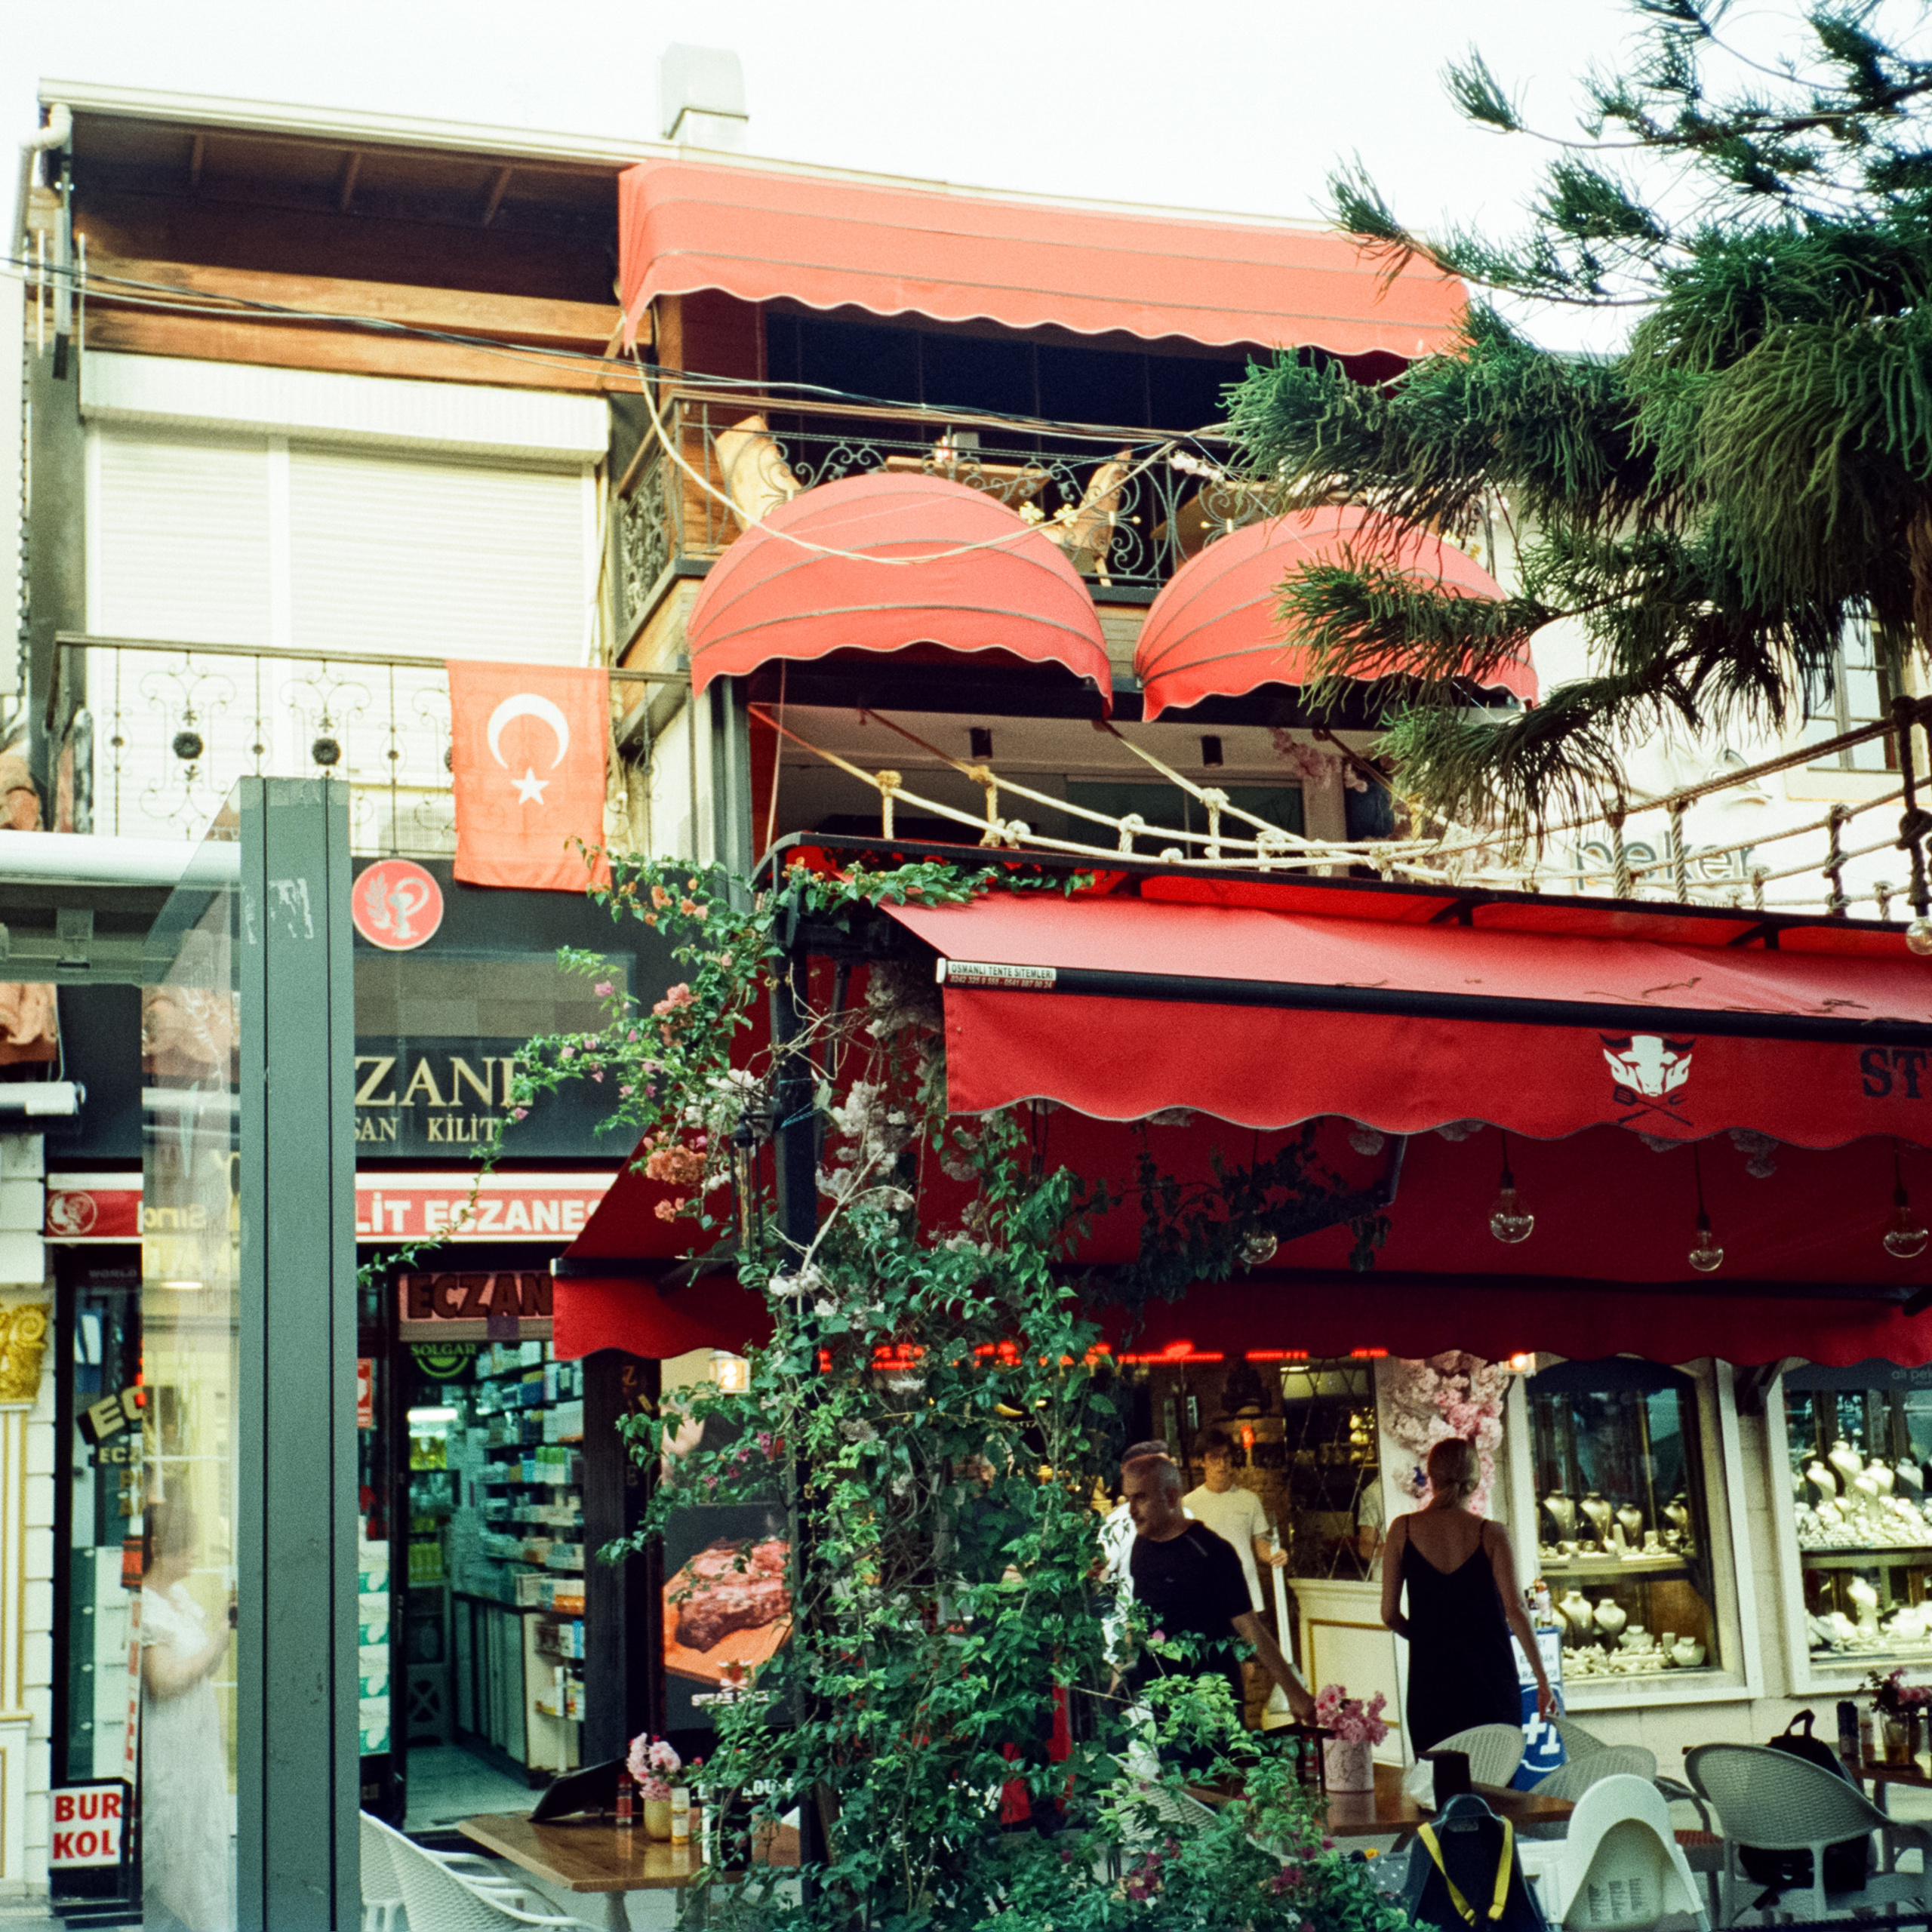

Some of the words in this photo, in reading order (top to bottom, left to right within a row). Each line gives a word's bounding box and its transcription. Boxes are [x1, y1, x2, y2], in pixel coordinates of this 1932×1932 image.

[989, 966, 1012, 977] TENTE
[1860, 1048, 1930, 1099] ST
[427, 1112, 497, 1142] KİLİT
[410, 1343, 477, 1356] SOLGAR
[55, 1792, 123, 1823] BUR
[53, 1829, 121, 1860] KOL
